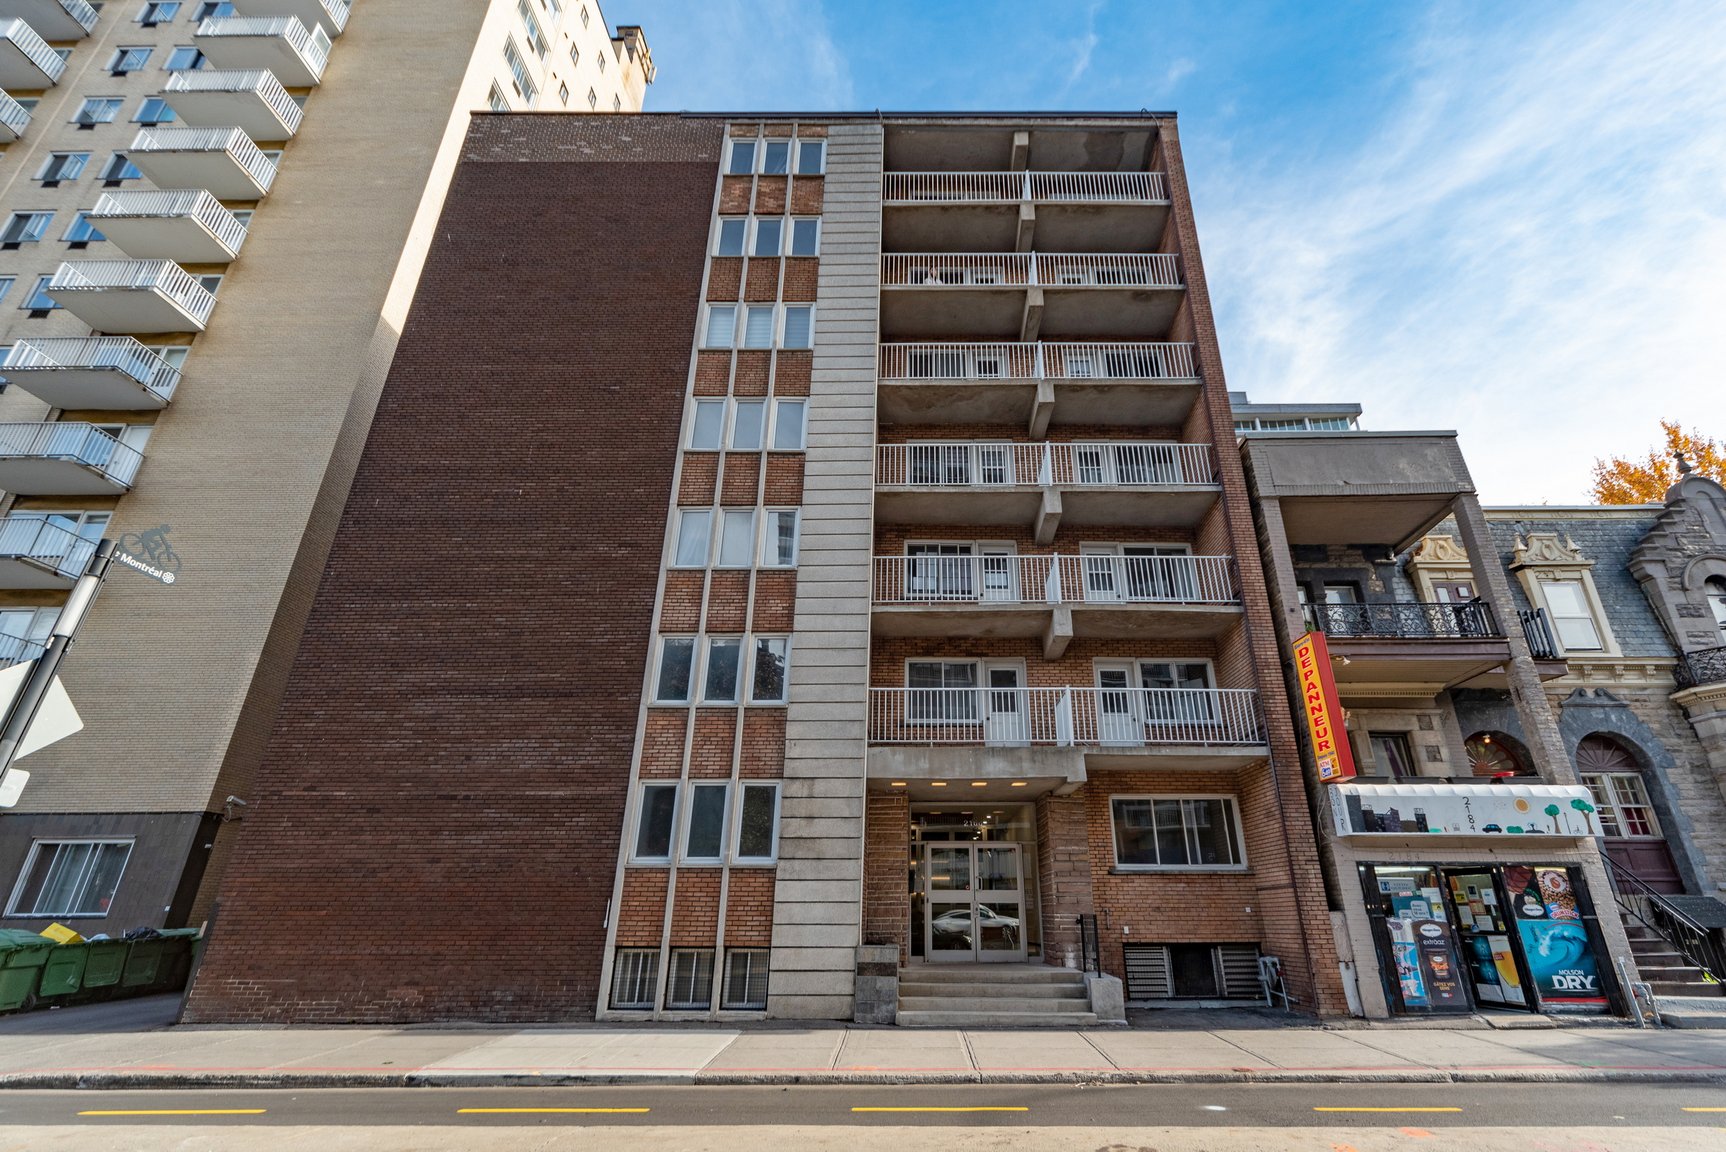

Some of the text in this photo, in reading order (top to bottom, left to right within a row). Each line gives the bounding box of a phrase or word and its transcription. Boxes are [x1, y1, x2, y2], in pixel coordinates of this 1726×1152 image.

[120, 552, 163, 578] Montréal
[1298, 646, 1331, 752] DEPANNEUR
[1462, 796, 1476, 833] 2184
[1551, 975, 1595, 990] DRY
